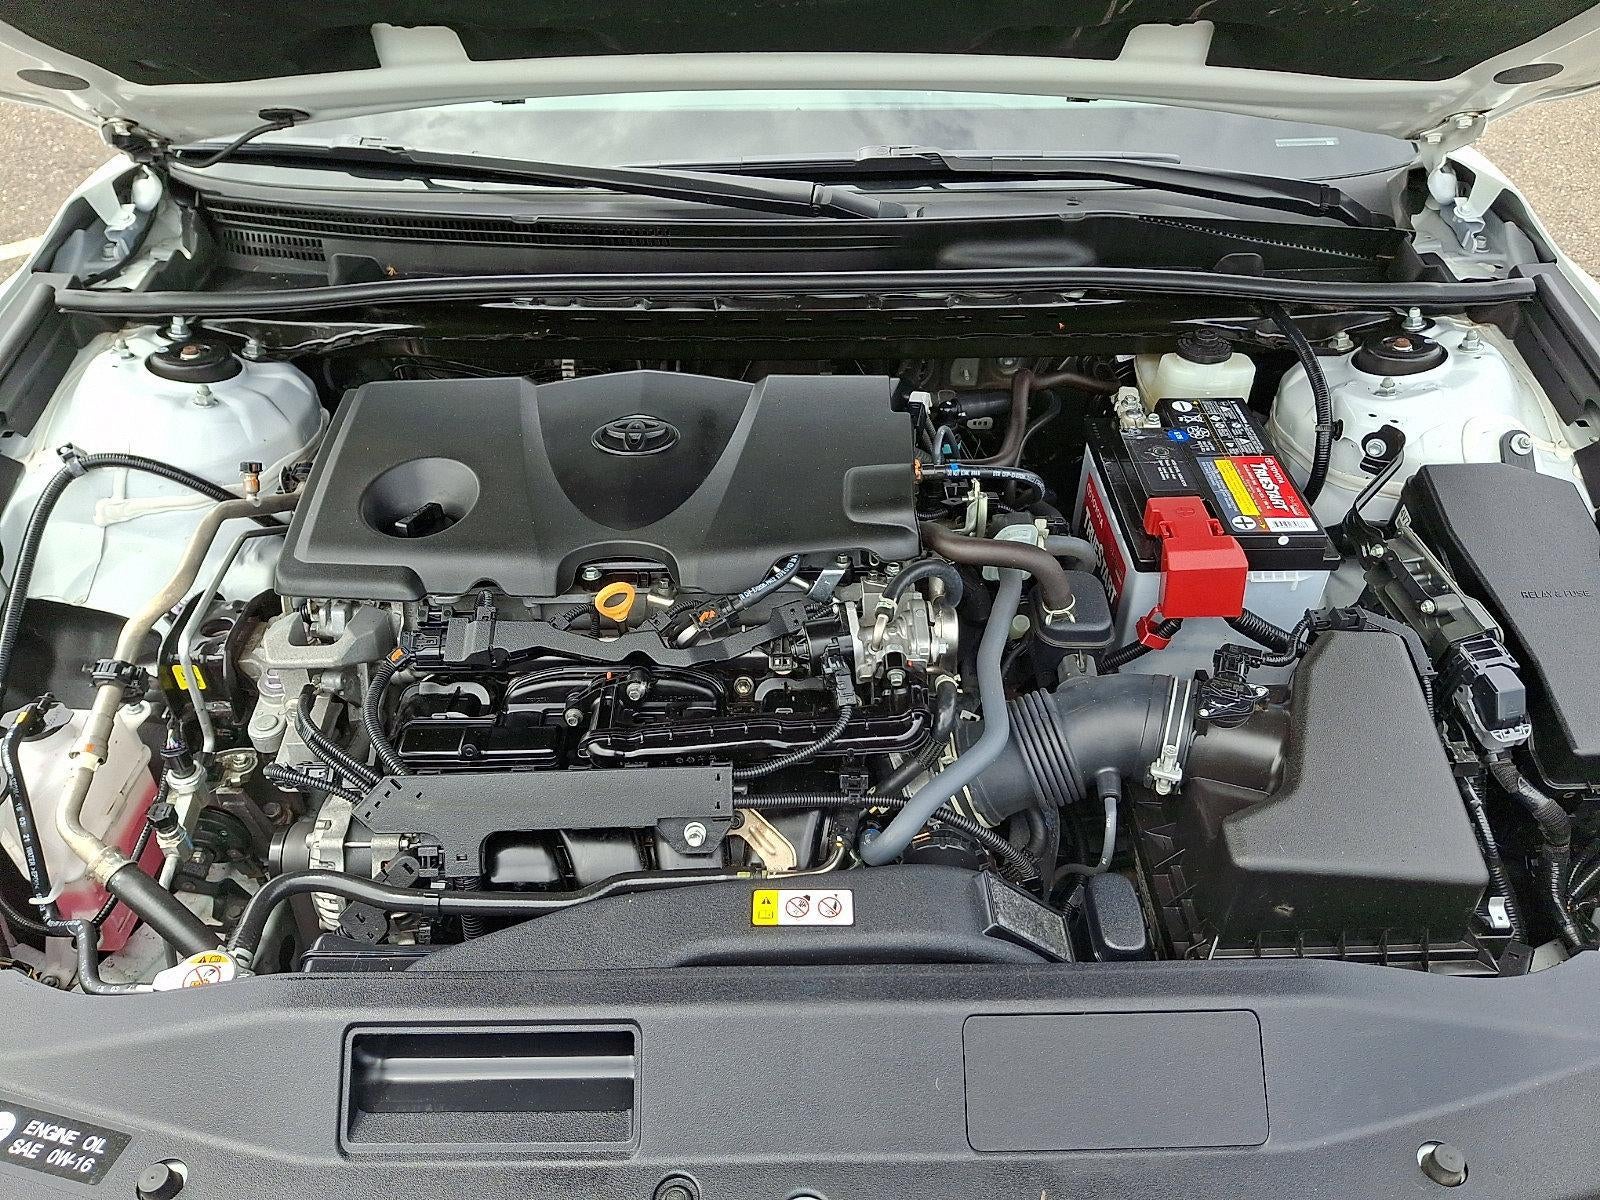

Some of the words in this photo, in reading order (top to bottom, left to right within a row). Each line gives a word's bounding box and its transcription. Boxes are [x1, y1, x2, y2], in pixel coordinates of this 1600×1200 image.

[1270, 464, 1286, 484] TOYOTA
[1520, 590, 1552, 599] RELAY
[1554, 590, 1562, 598] &
[1563, 589, 1591, 598] FUSE
[27, 845, 36, 866] WATER
[23, 1119, 81, 1146] ENGINE
[82, 1135, 107, 1154] OIL
[8, 1138, 44, 1159] SAE
[46, 1149, 96, 1173] 0W-16
